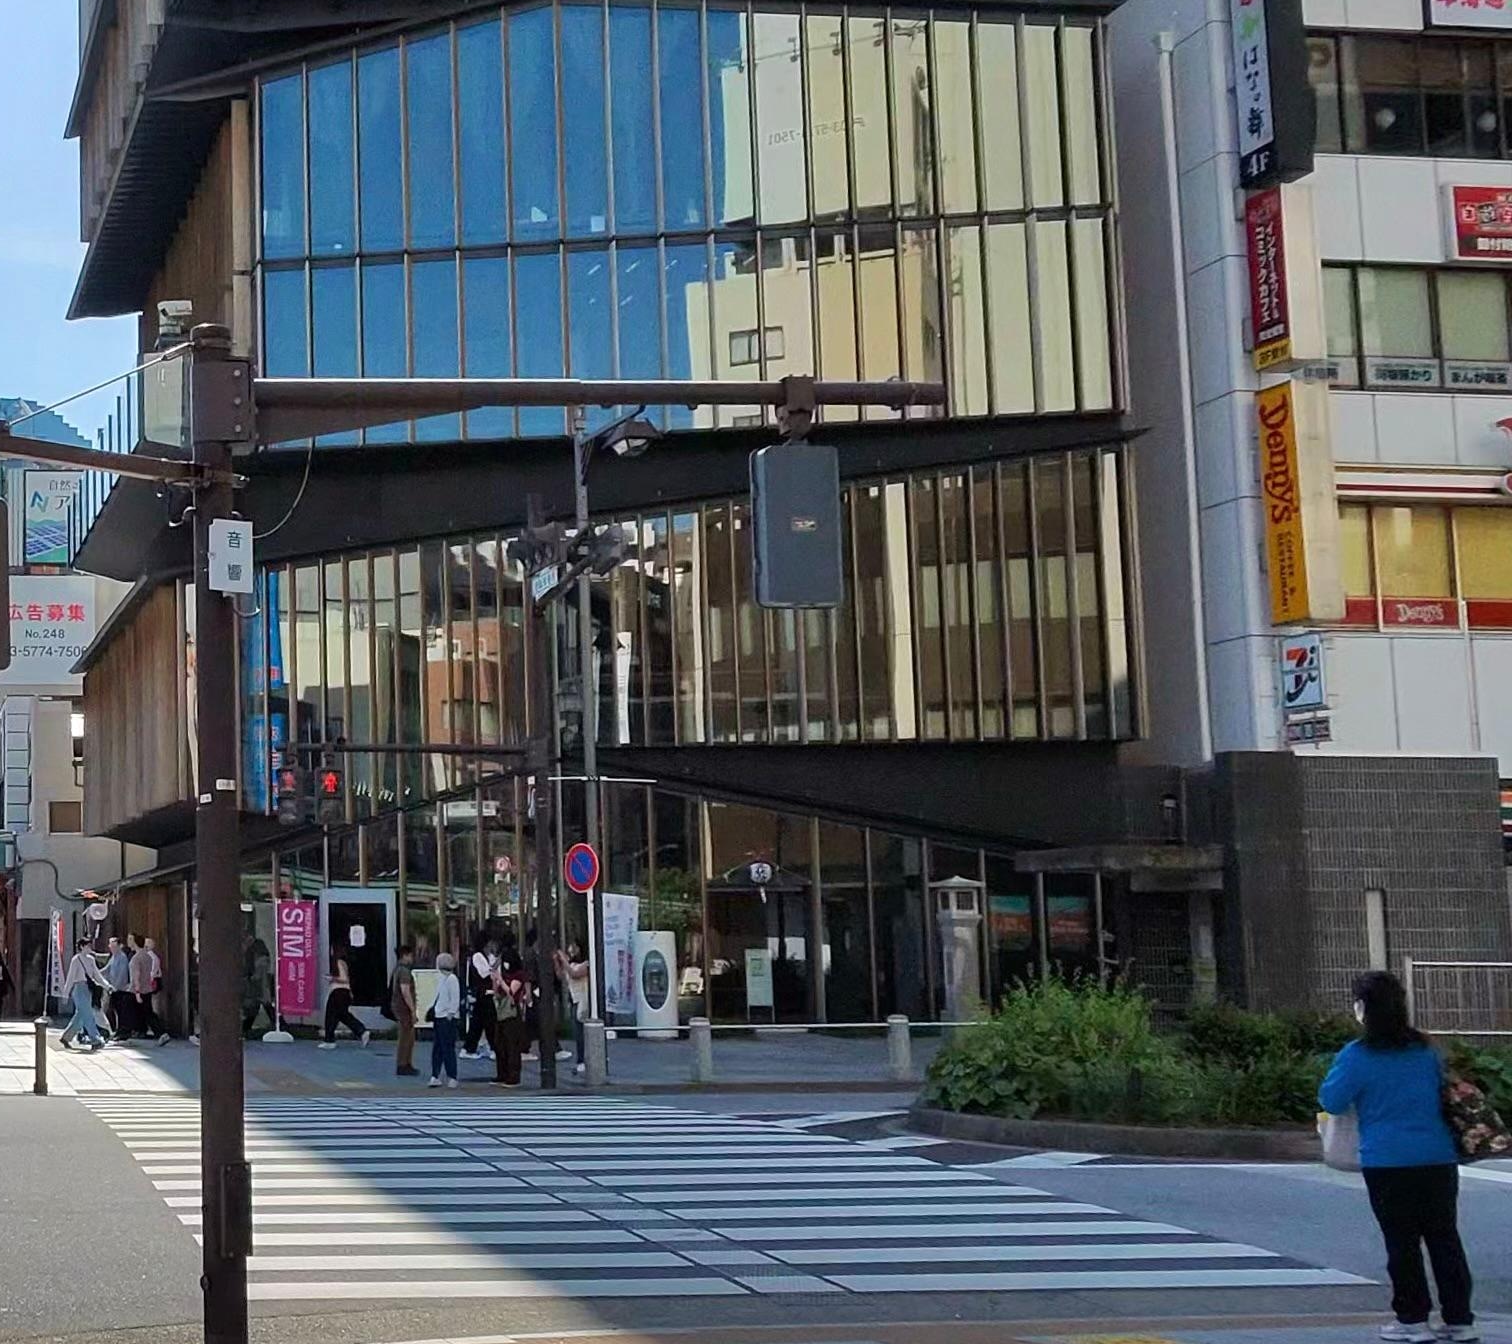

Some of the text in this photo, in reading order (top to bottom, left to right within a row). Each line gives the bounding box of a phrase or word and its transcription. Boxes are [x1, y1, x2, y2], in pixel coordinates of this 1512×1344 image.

[1246, 151, 1270, 178] 4F
[1259, 394, 1300, 525] Denny's
[227, 528, 243, 582] 音響
[10, 645, 88, 657] 3-5774-750
[25, 629, 65, 639] No.248
[282, 907, 304, 958] SIM
